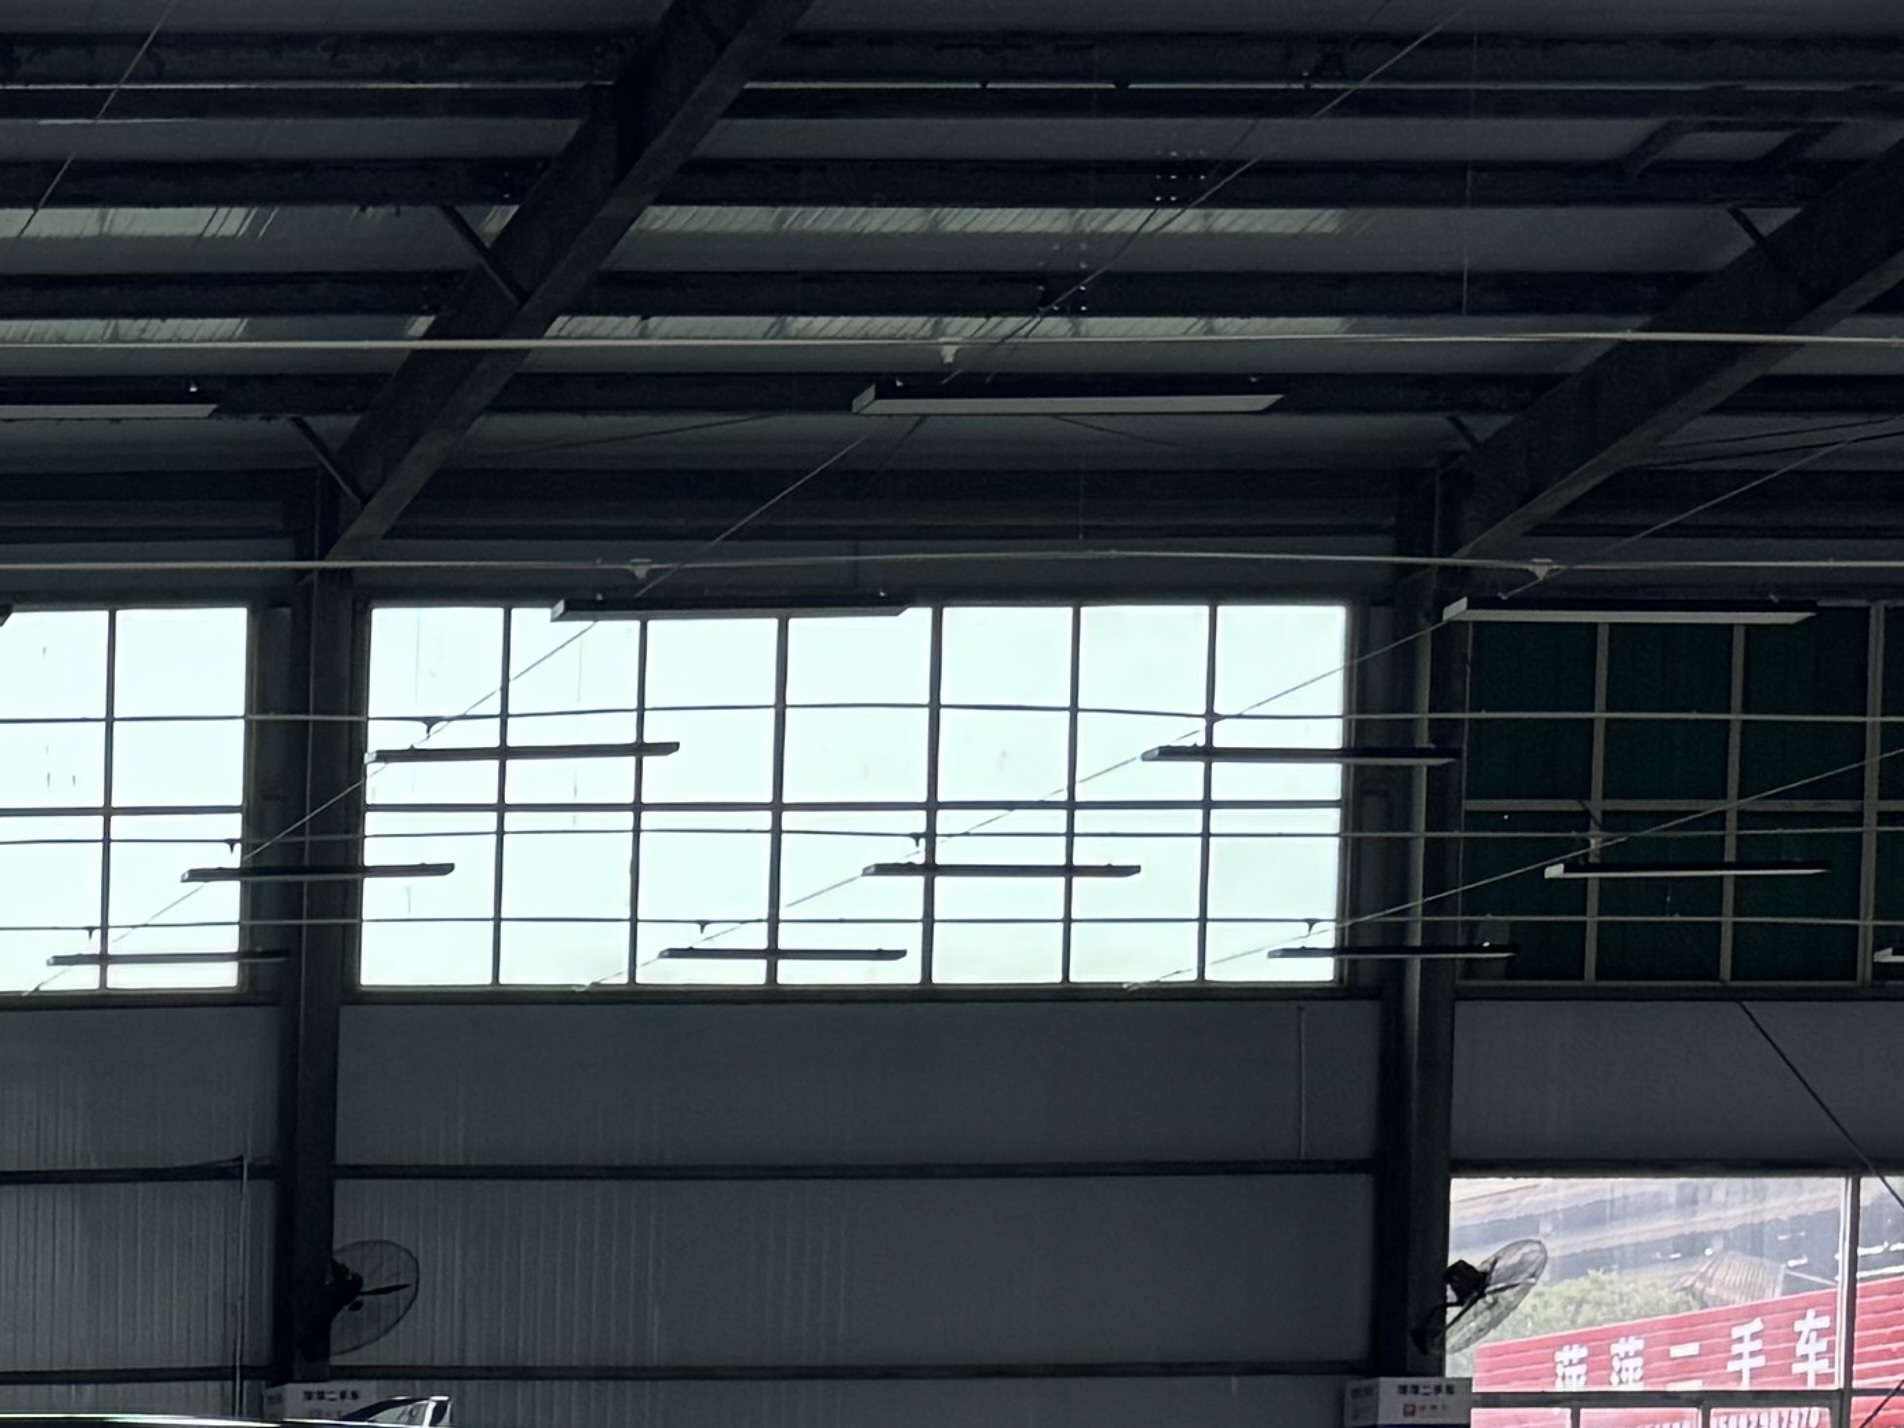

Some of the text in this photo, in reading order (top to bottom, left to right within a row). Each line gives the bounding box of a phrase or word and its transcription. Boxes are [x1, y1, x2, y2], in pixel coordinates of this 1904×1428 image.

[1554, 1308, 1831, 1391] 萍萍二手车
